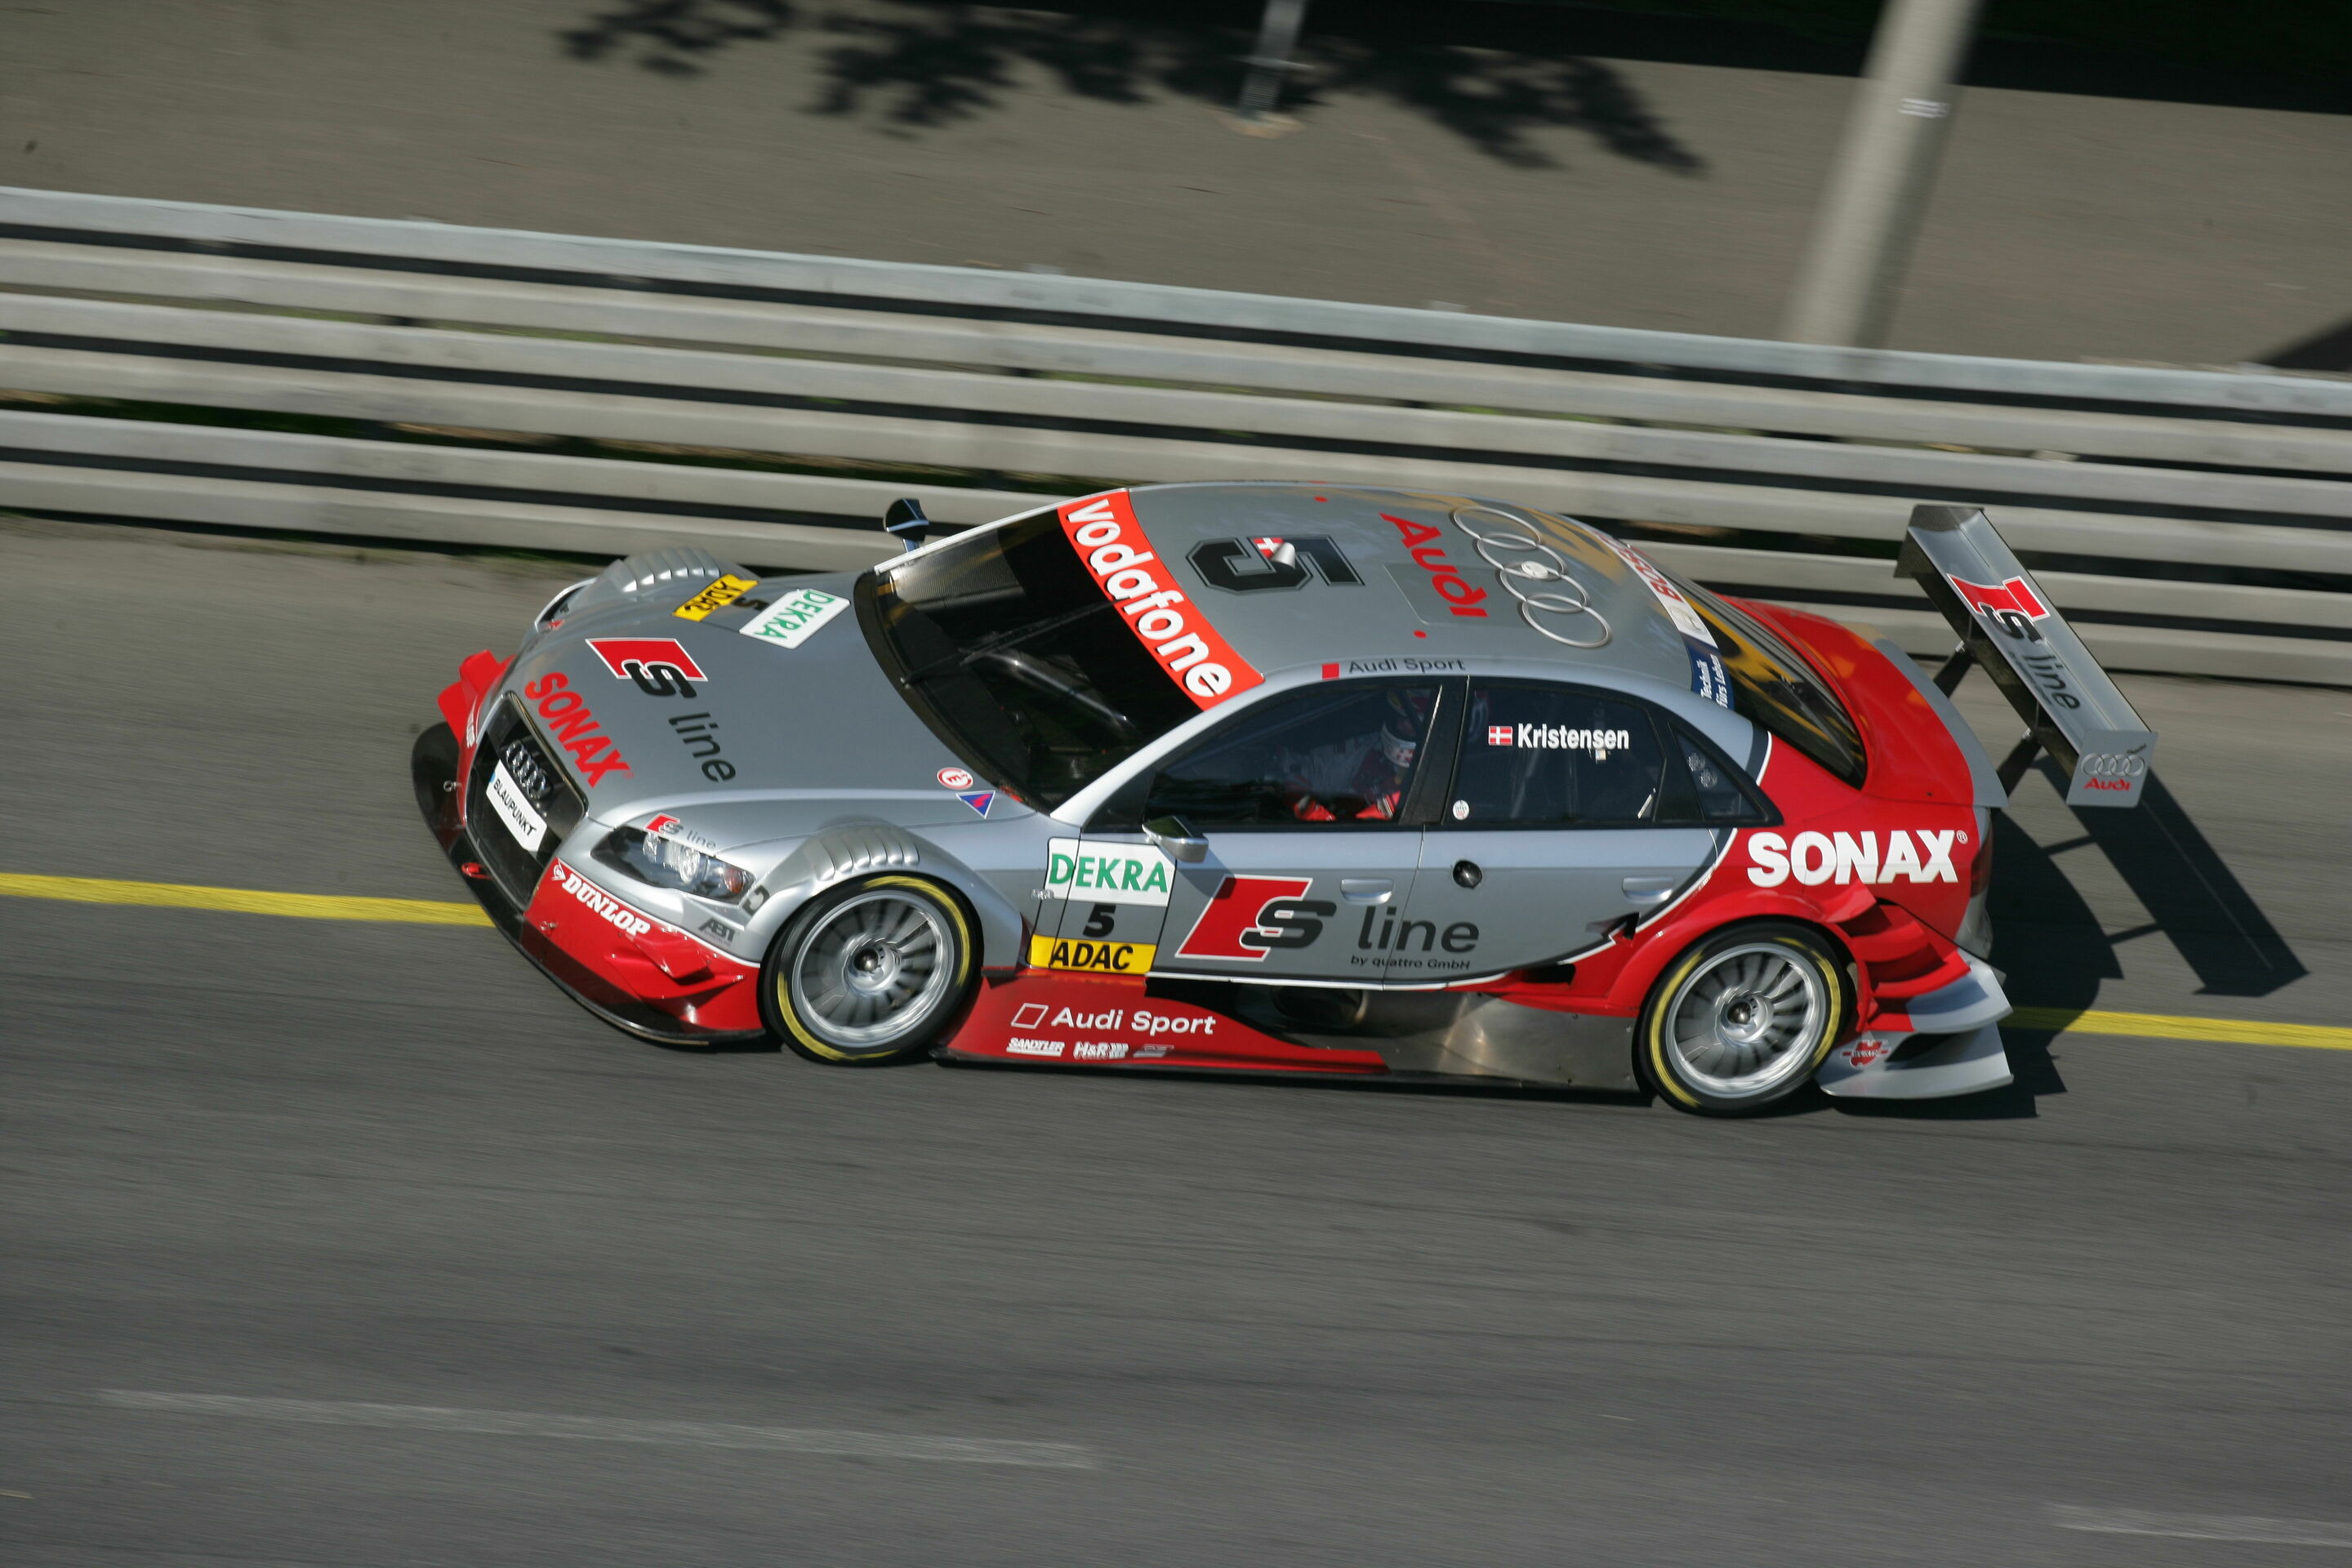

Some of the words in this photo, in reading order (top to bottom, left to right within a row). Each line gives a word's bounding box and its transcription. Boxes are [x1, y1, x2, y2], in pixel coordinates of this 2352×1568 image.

[1186, 534, 1365, 596] 5
[1379, 512, 1489, 617] Audi
[754, 591, 835, 639] DEKRA
[1067, 499, 1232, 697] vodafone
[1349, 658, 1398, 674] Audi
[1403, 657, 1467, 673] Sport
[2022, 655, 2081, 709] line
[524, 671, 631, 789] SONAX
[668, 712, 736, 782] line
[1517, 723, 1629, 750] Kristensen
[493, 778, 537, 836] BLAUPUNKT
[2083, 777, 2132, 791] Audi
[686, 830, 716, 849] line
[1747, 831, 1958, 888] SONAX
[1049, 853, 1168, 893] DEKRA
[561, 872, 652, 937] DUNLOP
[1083, 903, 1116, 938] 5
[698, 918, 735, 942] ABT
[1358, 906, 1480, 953] line
[1051, 941, 1134, 970] ADAC
[1351, 955, 1368, 966] by
[1372, 956, 1423, 969] quattro
[1428, 959, 1470, 970] GmbH
[1051, 1007, 1124, 1031] Audi
[1131, 1010, 1216, 1036] Sport
